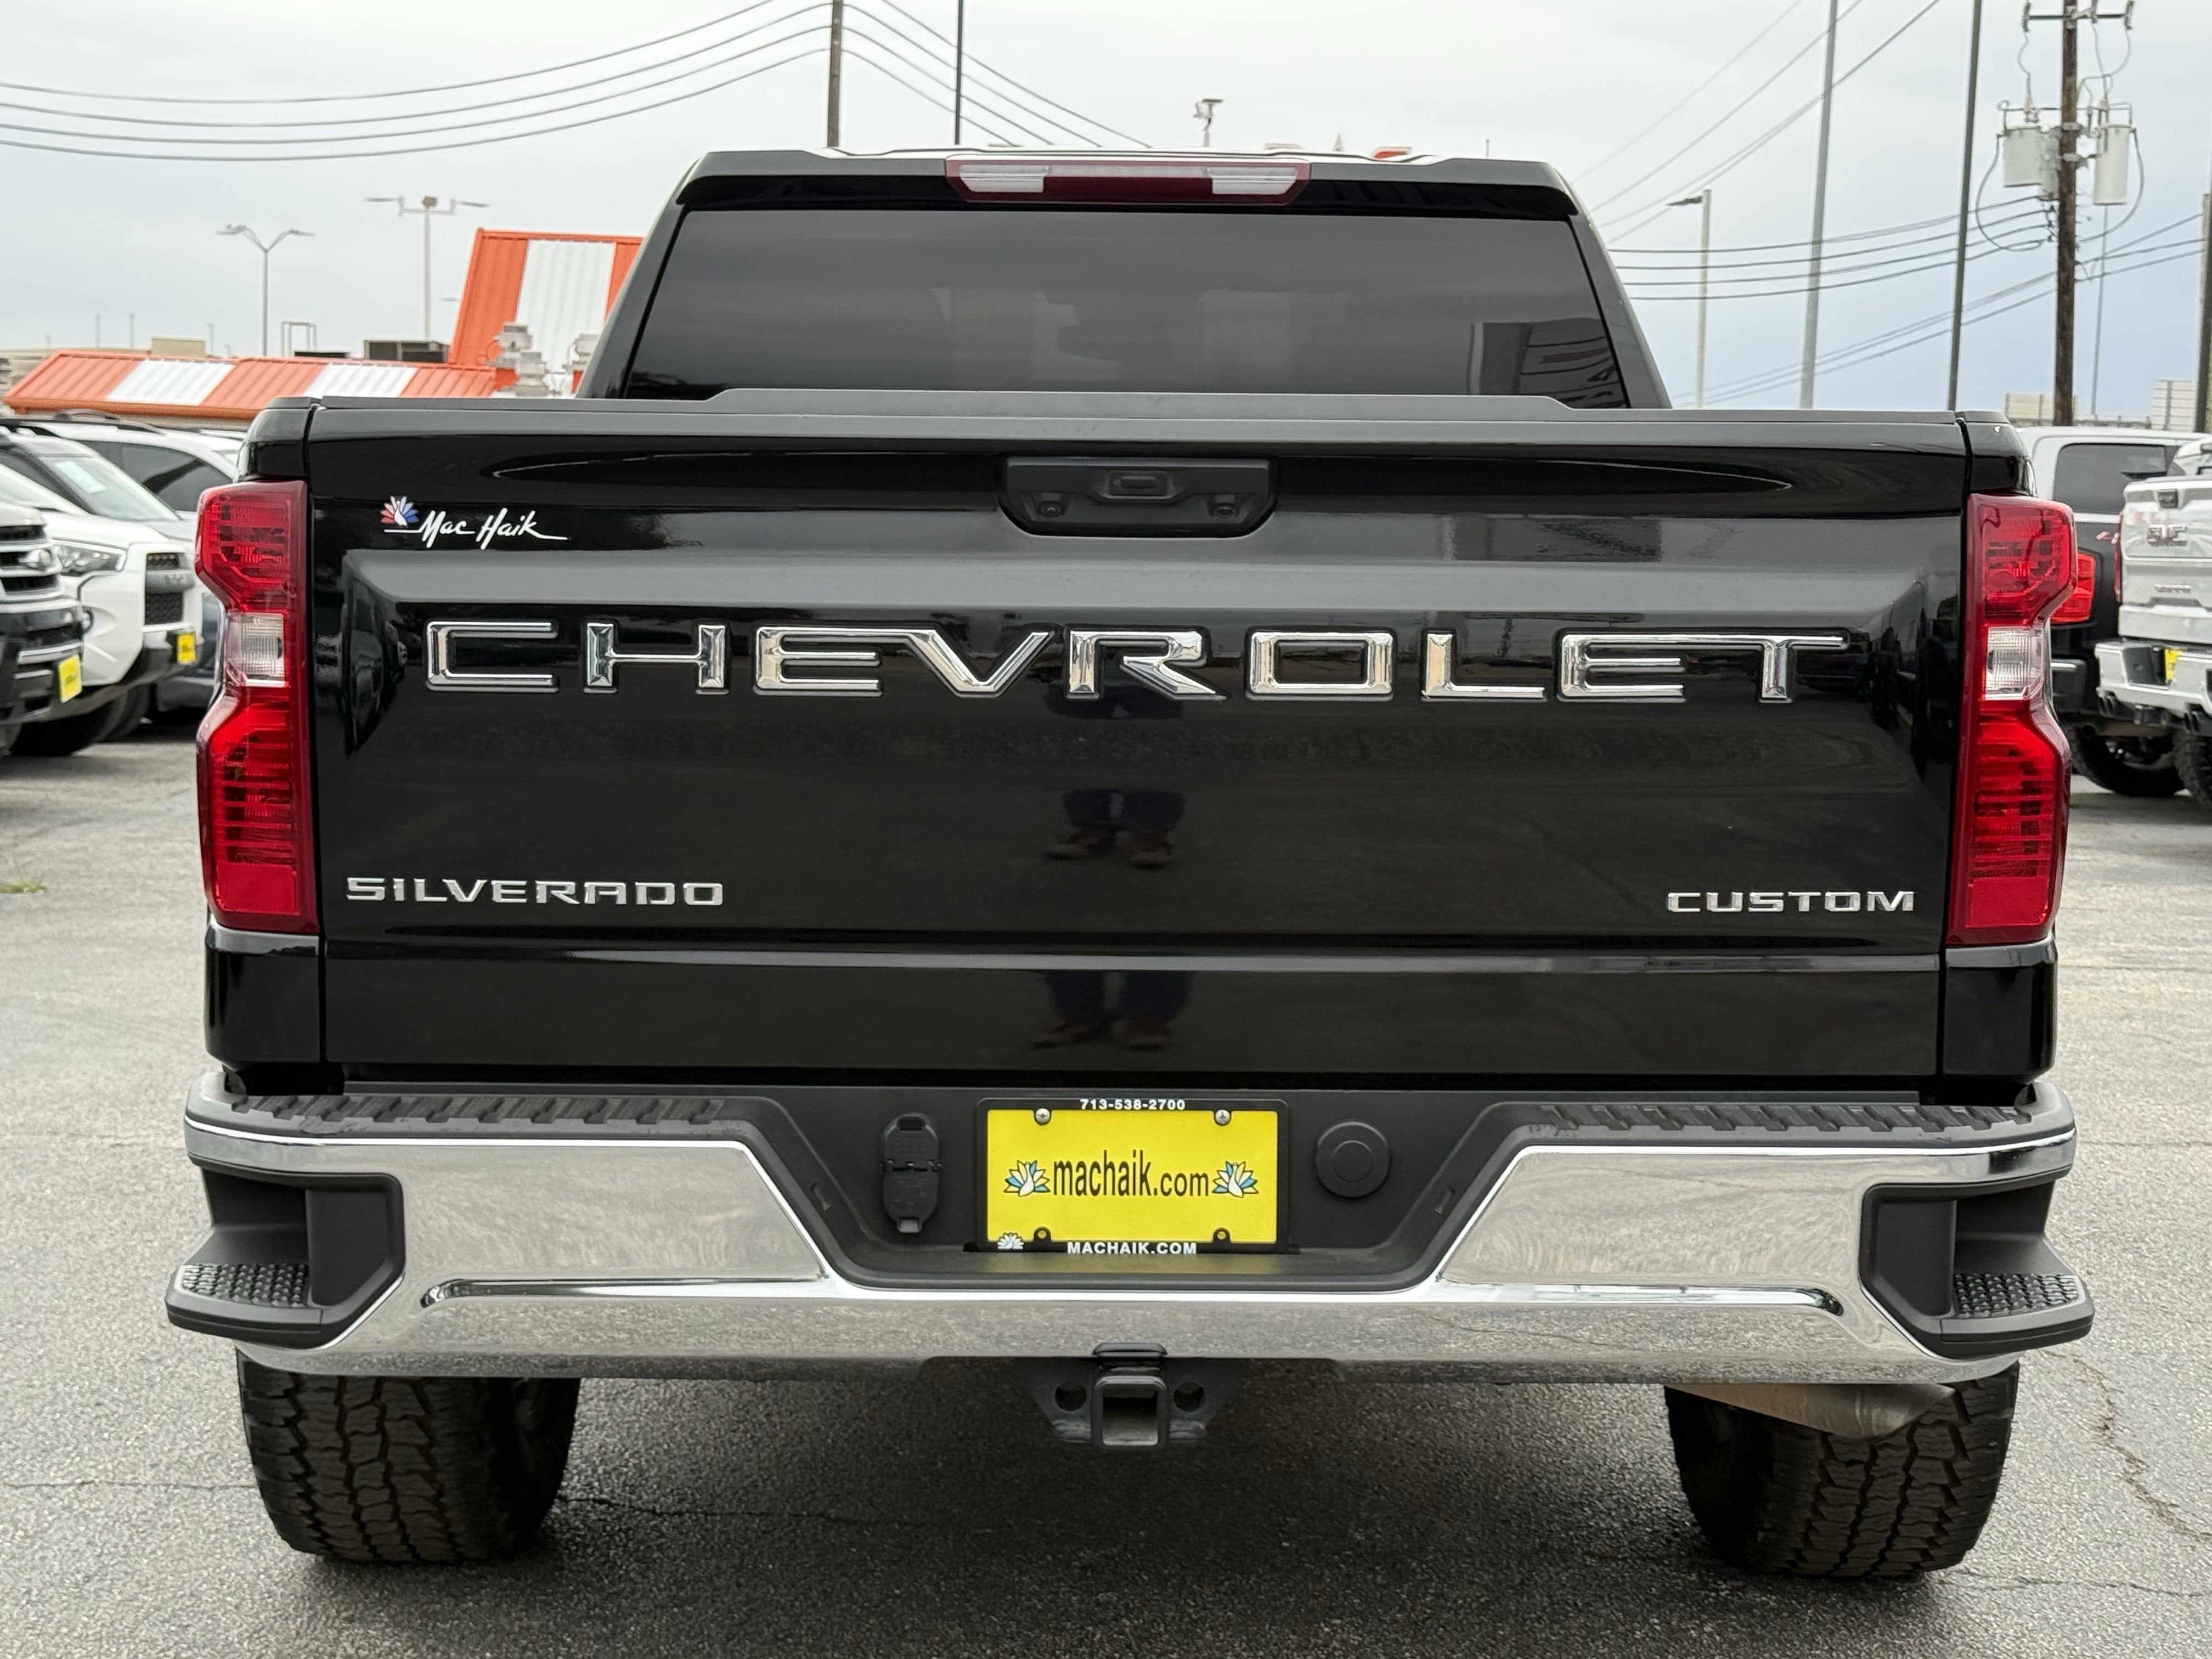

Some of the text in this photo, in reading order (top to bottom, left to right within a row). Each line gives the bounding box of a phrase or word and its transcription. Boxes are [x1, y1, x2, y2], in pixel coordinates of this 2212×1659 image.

[384, 507, 569, 550] Mac Haik
[426, 621, 1849, 704] CHEVROLET
[346, 877, 724, 906] SILVERADO
[1667, 891, 1915, 912] CUSTOM
[1080, 1099, 1186, 1110] 713-538-2700
[1053, 1149, 1209, 1197] machaik.com
[1067, 1242, 1197, 1255] MACHAIK.COM
